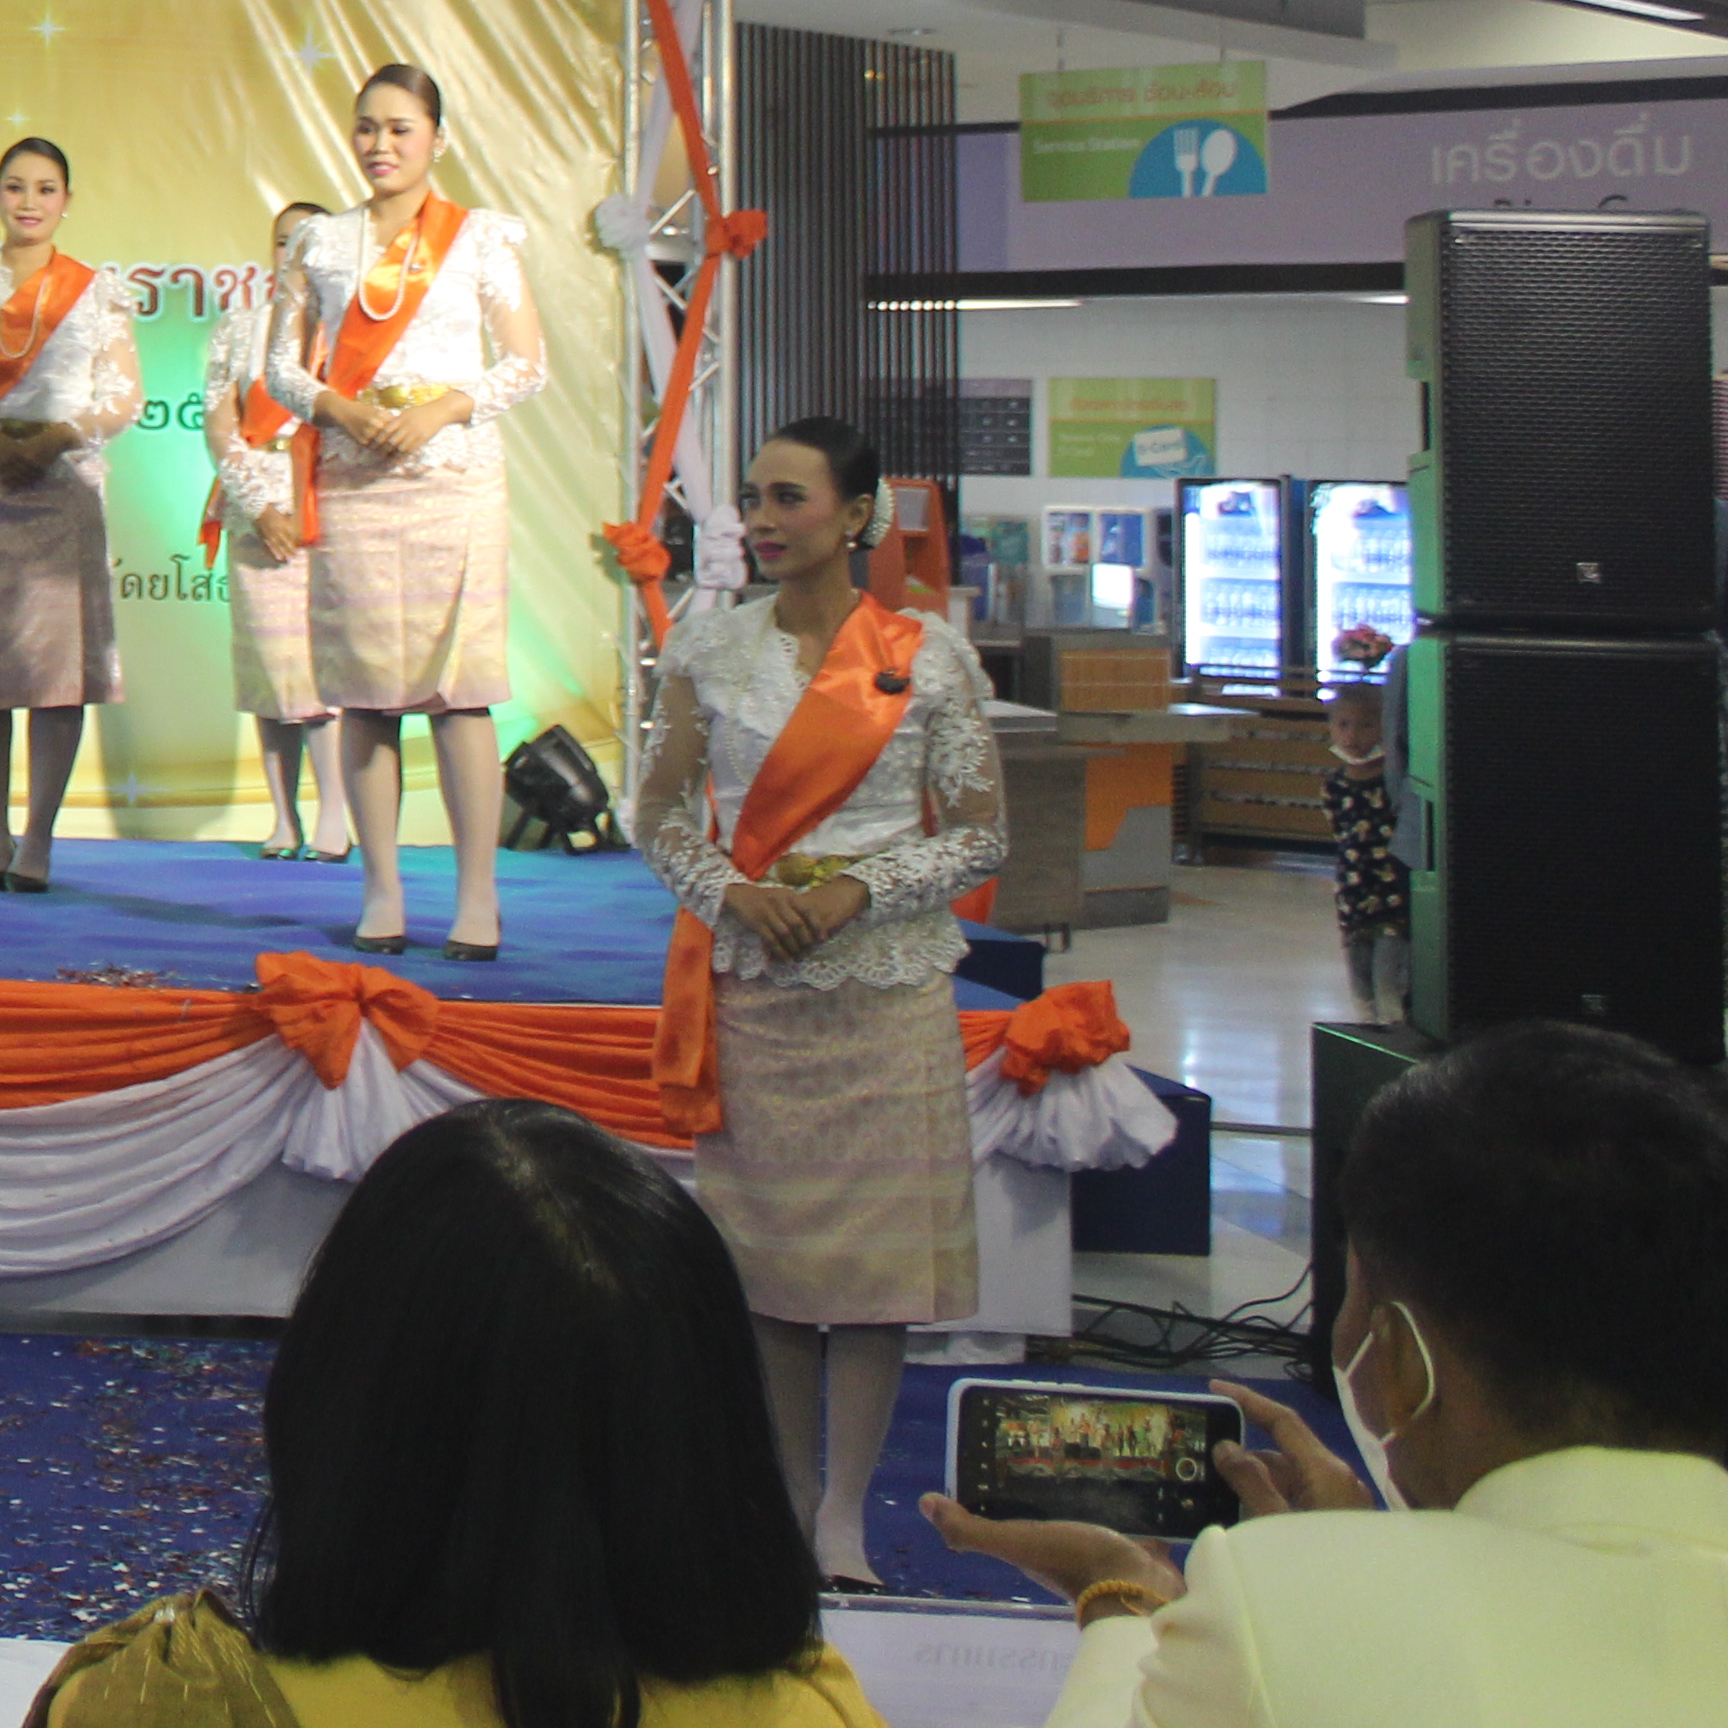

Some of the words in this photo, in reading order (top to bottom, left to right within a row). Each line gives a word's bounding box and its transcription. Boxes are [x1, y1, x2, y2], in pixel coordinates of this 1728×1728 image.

[1432, 113, 1694, 184] เครื่องดื่ม
